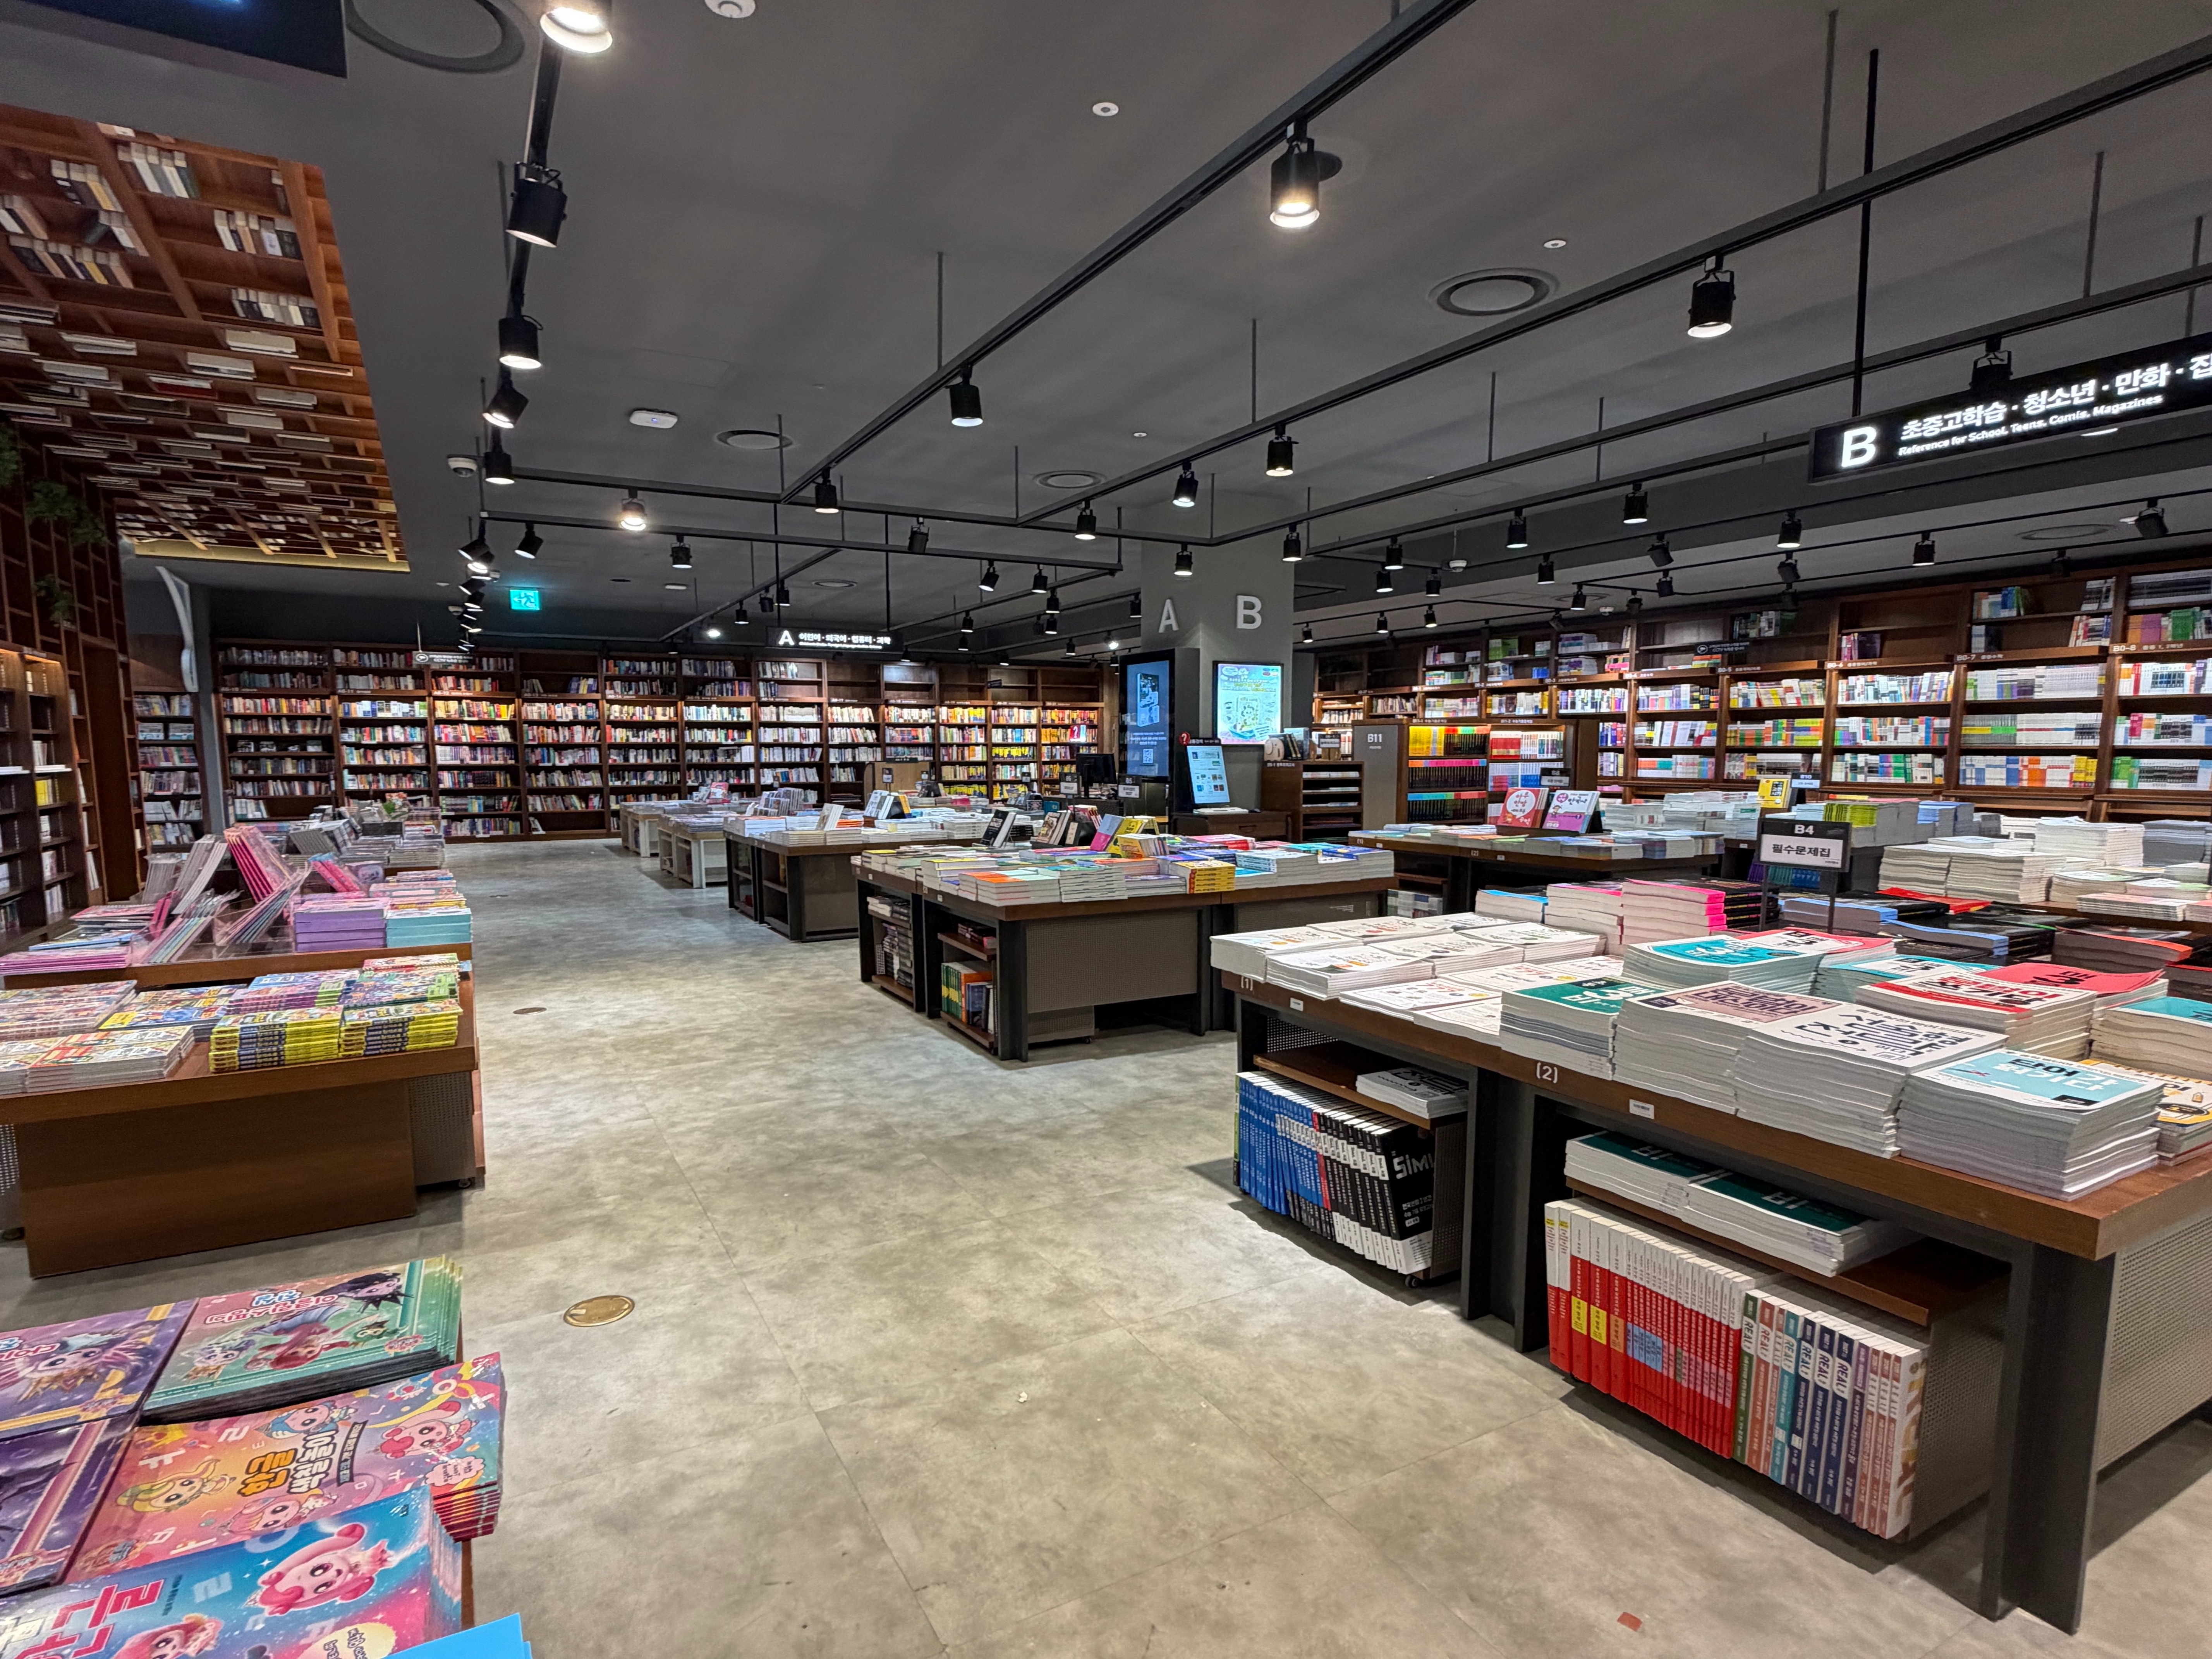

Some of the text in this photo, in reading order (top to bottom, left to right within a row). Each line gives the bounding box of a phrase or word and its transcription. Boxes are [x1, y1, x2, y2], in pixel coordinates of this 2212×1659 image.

[1841, 428, 1876, 467] B
[1901, 402, 2006, 442] 초중고학습
[2023, 380, 2096, 415] 청소년
[2114, 364, 2167, 395] 만화
[1899, 440, 1949, 456] Reference
[1951, 434, 1966, 445] for
[2093, 395, 2162, 416] Magazines
[1159, 599, 1179, 633] A
[1237, 595, 1262, 629] B
[779, 630, 794, 645] A
[799, 633, 821, 641] 어린이
[1367, 734, 1382, 743] B11
[1795, 824, 1814, 835] B4
[1772, 844, 1831, 857] 필수문제집
[1711, 988, 1818, 1011] 문법이
[1938, 976, 2063, 999] 문법이
[1691, 991, 1800, 1015] 내신이다
[1536, 1062, 1558, 1084] (2)
[1993, 1062, 2104, 1091] 읽기다
[2008, 1058, 2119, 1085] 단어가
[237, 1449, 298, 1496] 한글
[287, 1430, 338, 1494] 색칠놀이
